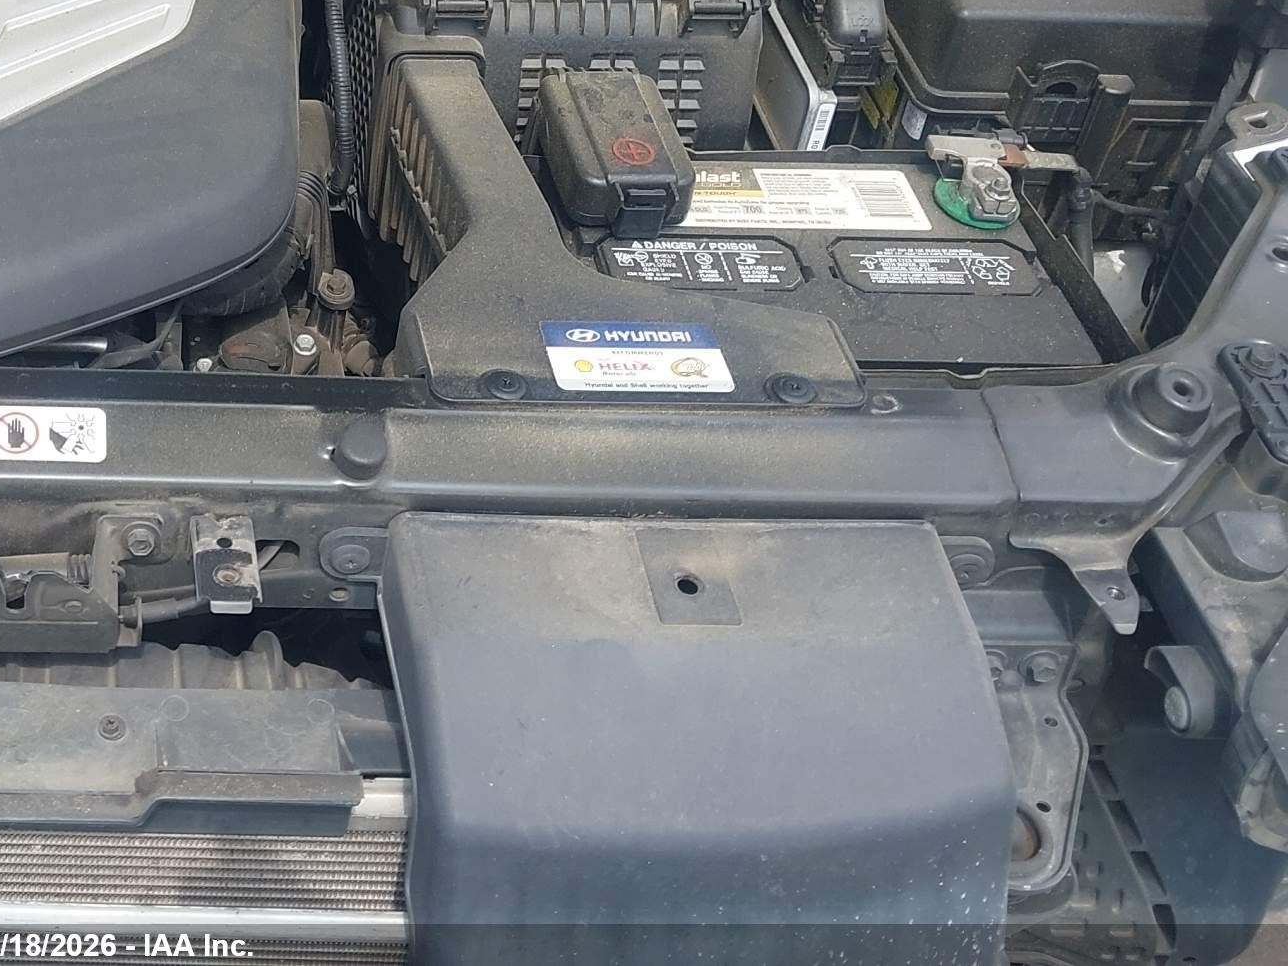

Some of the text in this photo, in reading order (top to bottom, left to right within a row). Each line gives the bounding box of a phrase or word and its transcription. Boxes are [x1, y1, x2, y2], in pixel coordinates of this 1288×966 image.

[644, 241, 758, 251] DANGER / POISON
[604, 330, 692, 342] HYUNDAI
[585, 382, 614, 390] Hyundai
